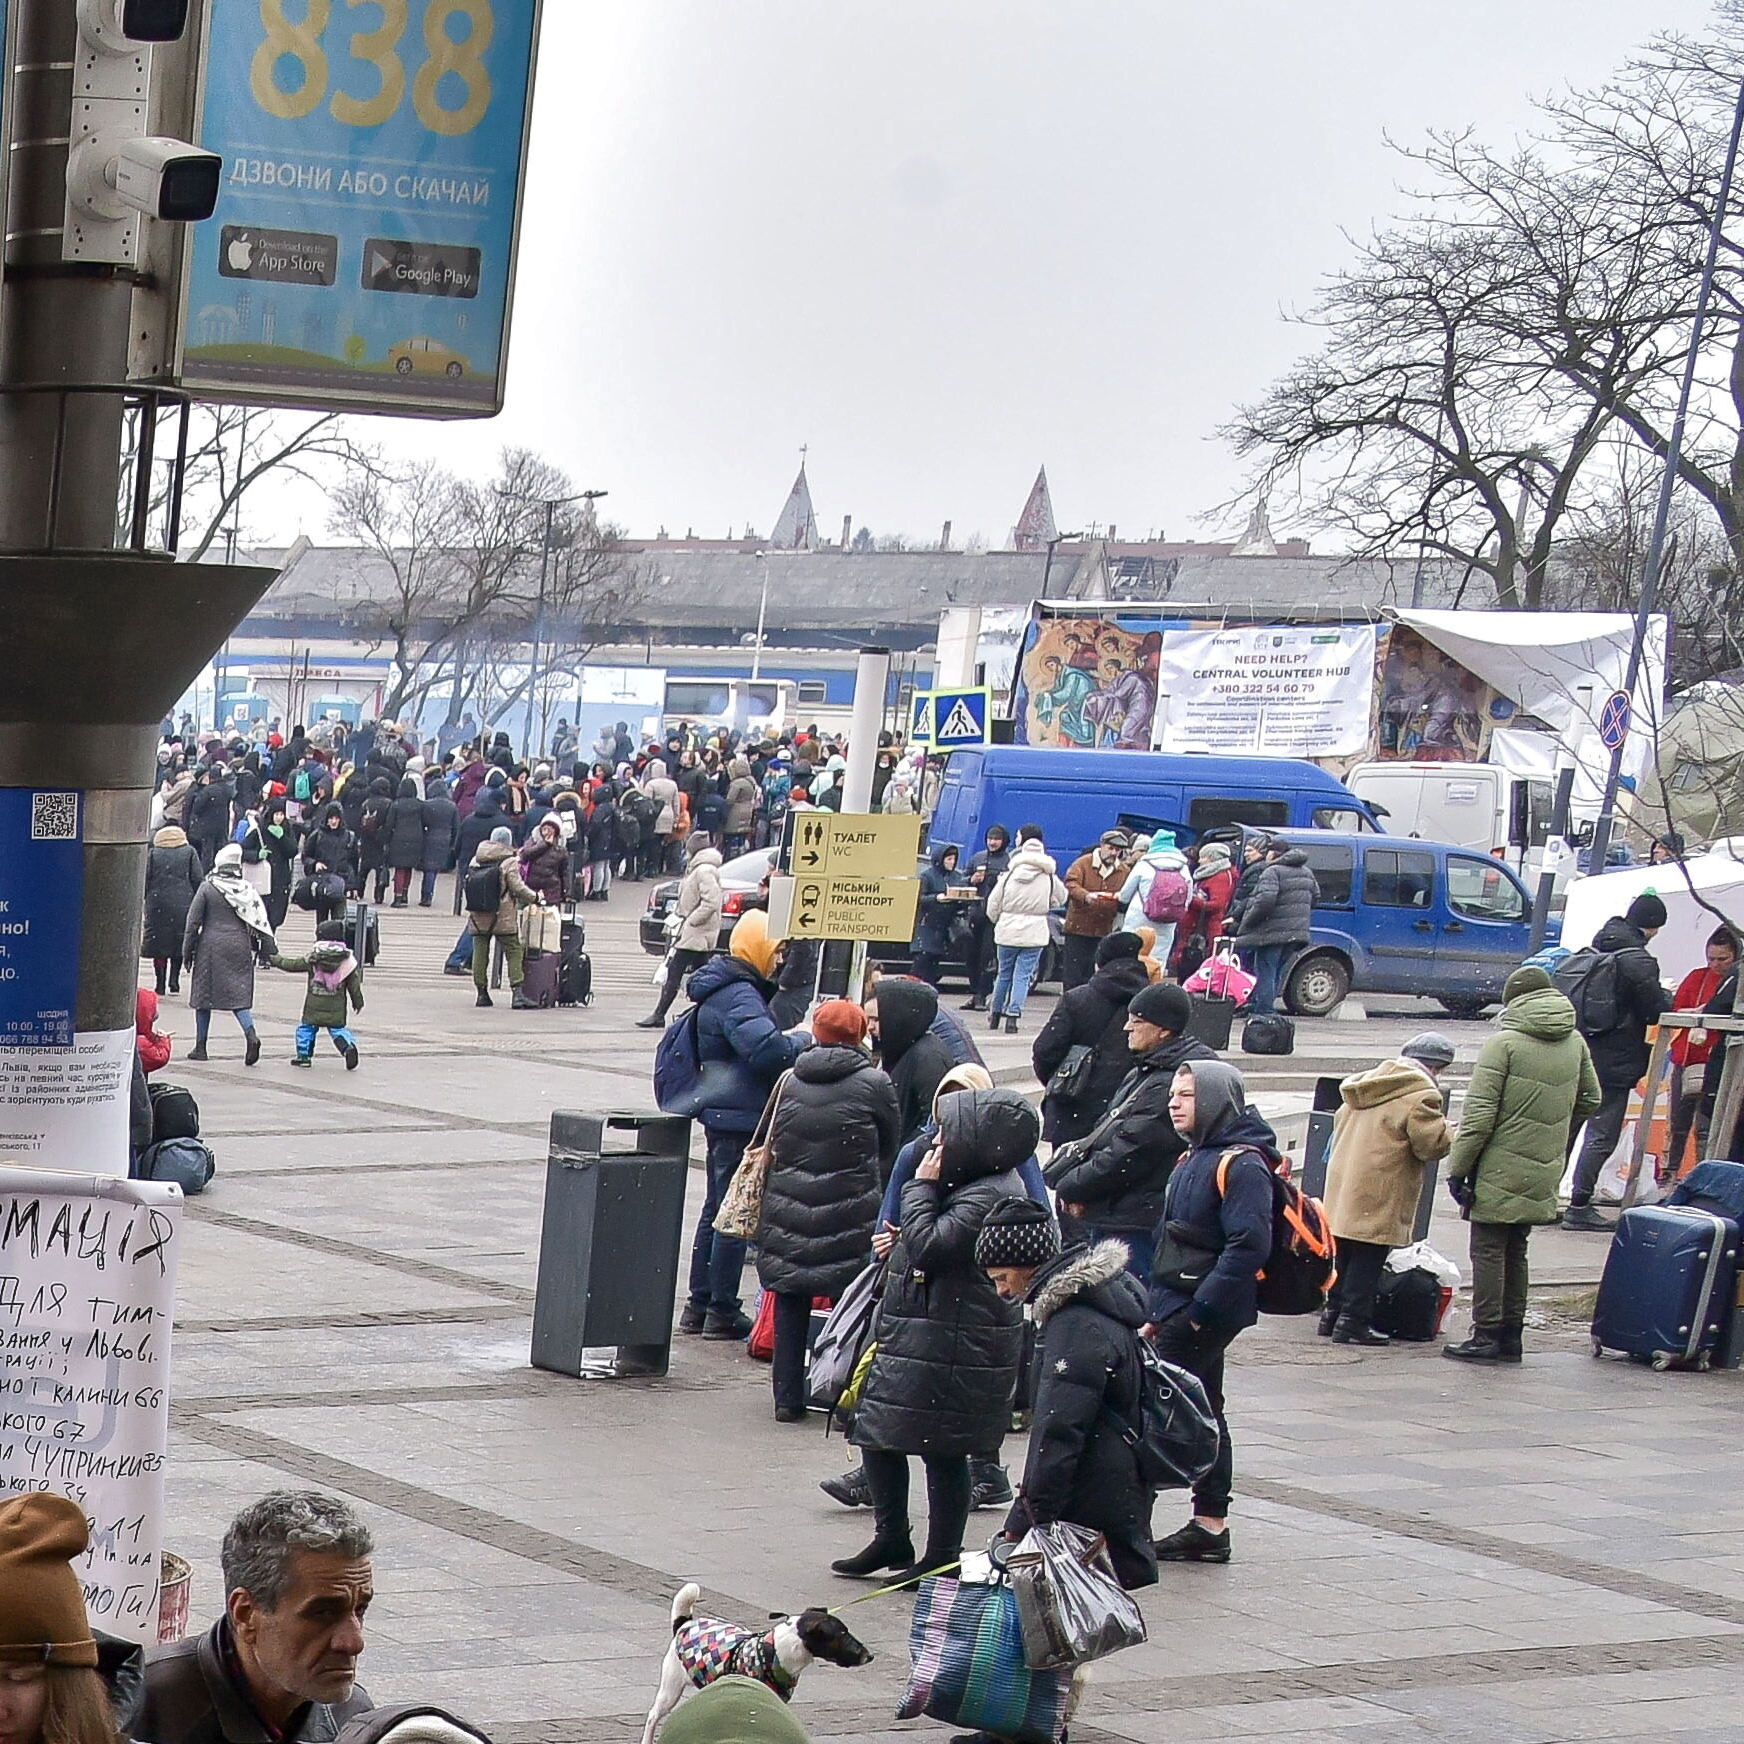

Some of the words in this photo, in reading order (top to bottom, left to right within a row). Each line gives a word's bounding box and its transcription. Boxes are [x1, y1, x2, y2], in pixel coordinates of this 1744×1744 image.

[250, 0, 493, 136] 838
[229, 158, 332, 192] ДЗВОНИ
[338, 170, 387, 196] АБО
[395, 176, 490, 207] СКАЧАЙ
[259, 252, 287, 271] App
[291, 256, 325, 275] Store
[396, 264, 441, 284] Google
[444, 270, 471, 286] Play
[1234, 654, 1266, 664] NEED
[1270, 654, 1308, 664] HELP?
[1192, 669, 1248, 679] CENTRAL
[1251, 668, 1323, 678] VOLUNTEER
[1326, 667, 1350, 676] HUB
[1212, 684, 1240, 693] +380
[1242, 684, 1263, 693] 322
[1266, 684, 1280, 693] 54
[1283, 684, 1298, 693] 60
[1302, 683, 1315, 693] 79
[834, 833, 877, 844] ТУАЛЕТ
[832, 846, 851, 856] WC
[831, 881, 881, 894] МІСЬКИЙ
[831, 895, 894, 907] ТРАНСПОРТ
[828, 910, 865, 922] PUBLIC
[827, 923, 890, 935] TRANSPORT
[18, 1045, 77, 1057] переміщені
[1, 1062, 31, 1073] Львів,
[37, 1064, 62, 1073] якщо
[14, 1074, 26, 1082] на
[30, 1073, 63, 1082] певний
[52, 1386, 128, 1408] КАЛИНИ
[134, 1387, 164, 1409] 66
[53, 1420, 86, 1443] 67
[24, 1435, 142, 1481] ЧУПРИНКИ
[142, 1452, 166, 1473] 85
[108, 1514, 146, 1543] 11
